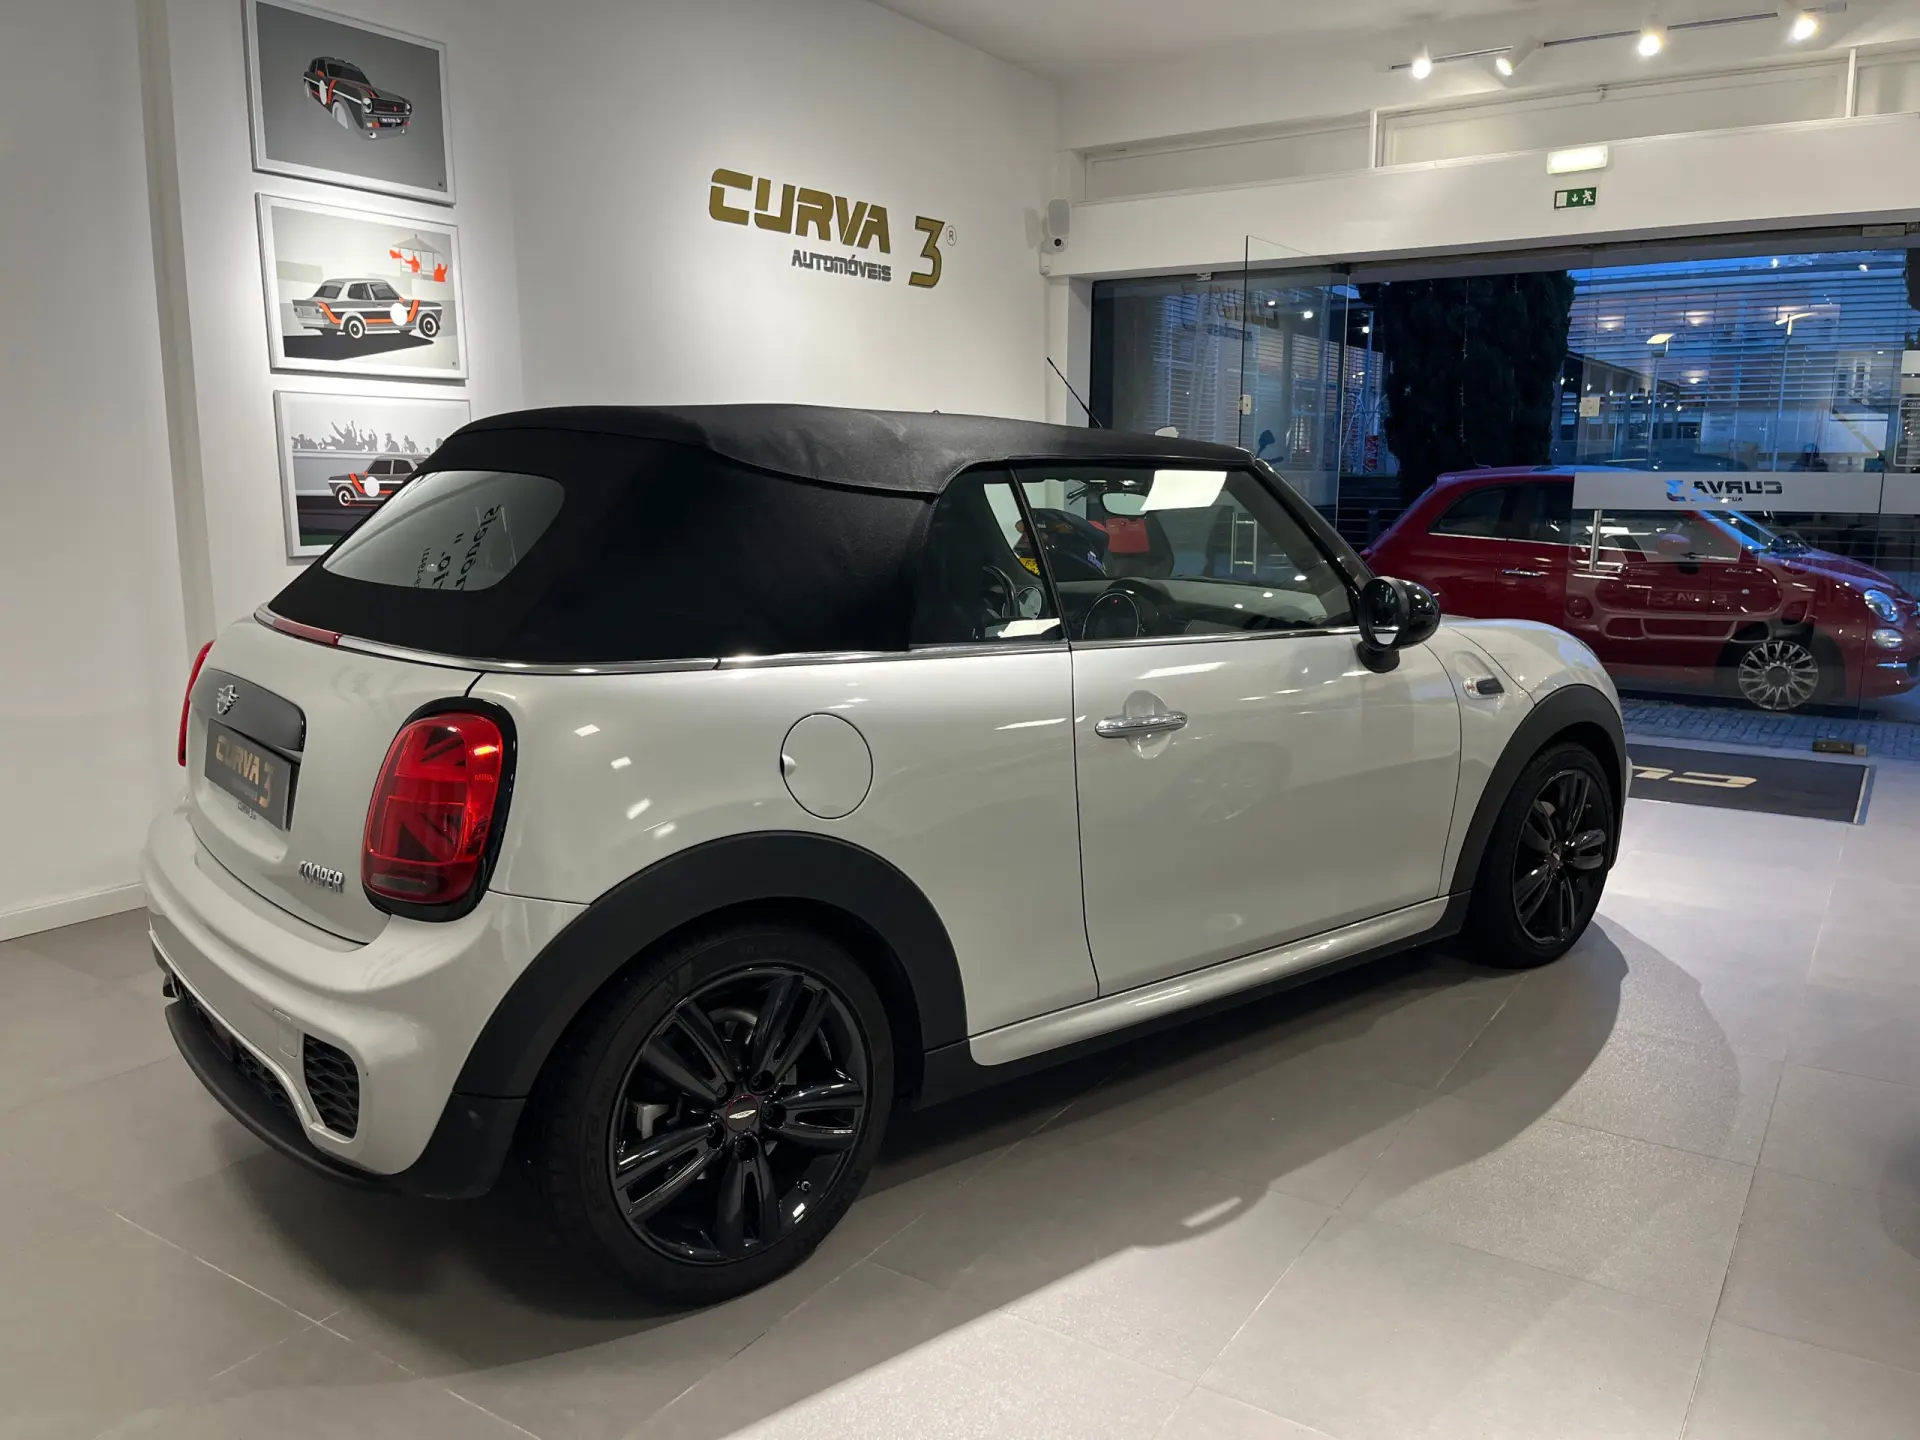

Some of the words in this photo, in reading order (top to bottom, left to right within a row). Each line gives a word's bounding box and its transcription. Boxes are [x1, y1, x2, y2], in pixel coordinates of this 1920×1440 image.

[709, 168, 891, 253] CURVA
[215, 733, 260, 786] CURVA
[299, 859, 345, 893] COOPER
